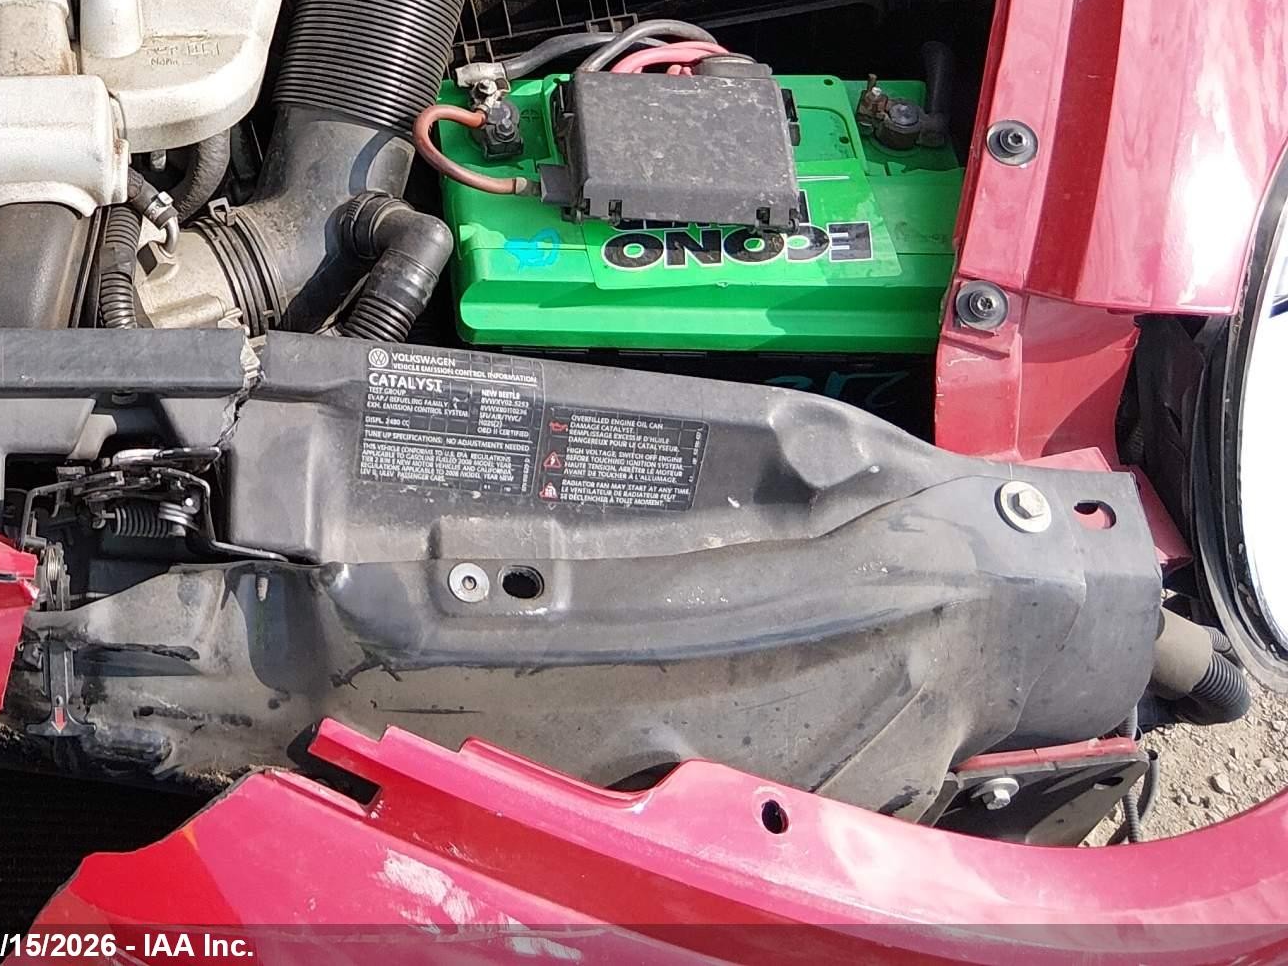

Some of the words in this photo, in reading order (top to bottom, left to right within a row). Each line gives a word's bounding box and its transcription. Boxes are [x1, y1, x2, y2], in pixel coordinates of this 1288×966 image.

[601, 221, 874, 270] ECONO
[392, 352, 456, 366] VOLKSWAGEN
[393, 363, 420, 372] VEHICLE
[421, 365, 453, 375] EMISSION
[455, 369, 486, 378] CONTROL
[488, 372, 537, 383] INFORMATION
[368, 373, 443, 392] CATALYST
[482, 389, 497, 397] NEW
[570, 422, 600, 431] DAMAGE
[571, 415, 609, 424] OVERFILLED
[611, 418, 635, 427] ENGINE
[364, 430, 382, 438] TUNE
[446, 437, 456, 445] NO
[458, 439, 503, 449] ADJUSTMENTS
[505, 443, 529, 452] NEEDED
[568, 436, 608, 446] DANGEREUX
[609, 440, 628, 448] POUR
[566, 454, 589, 463] BEFORE
[567, 447, 584, 455] HIGH
[658, 455, 683, 463] ENGINE
[656, 468, 683, 477] MOTEUR
[562, 479, 595, 489] RADIATOR
[596, 481, 609, 489] FAN
[611, 483, 626, 491] MAY
[658, 486, 673, 494] ANY
